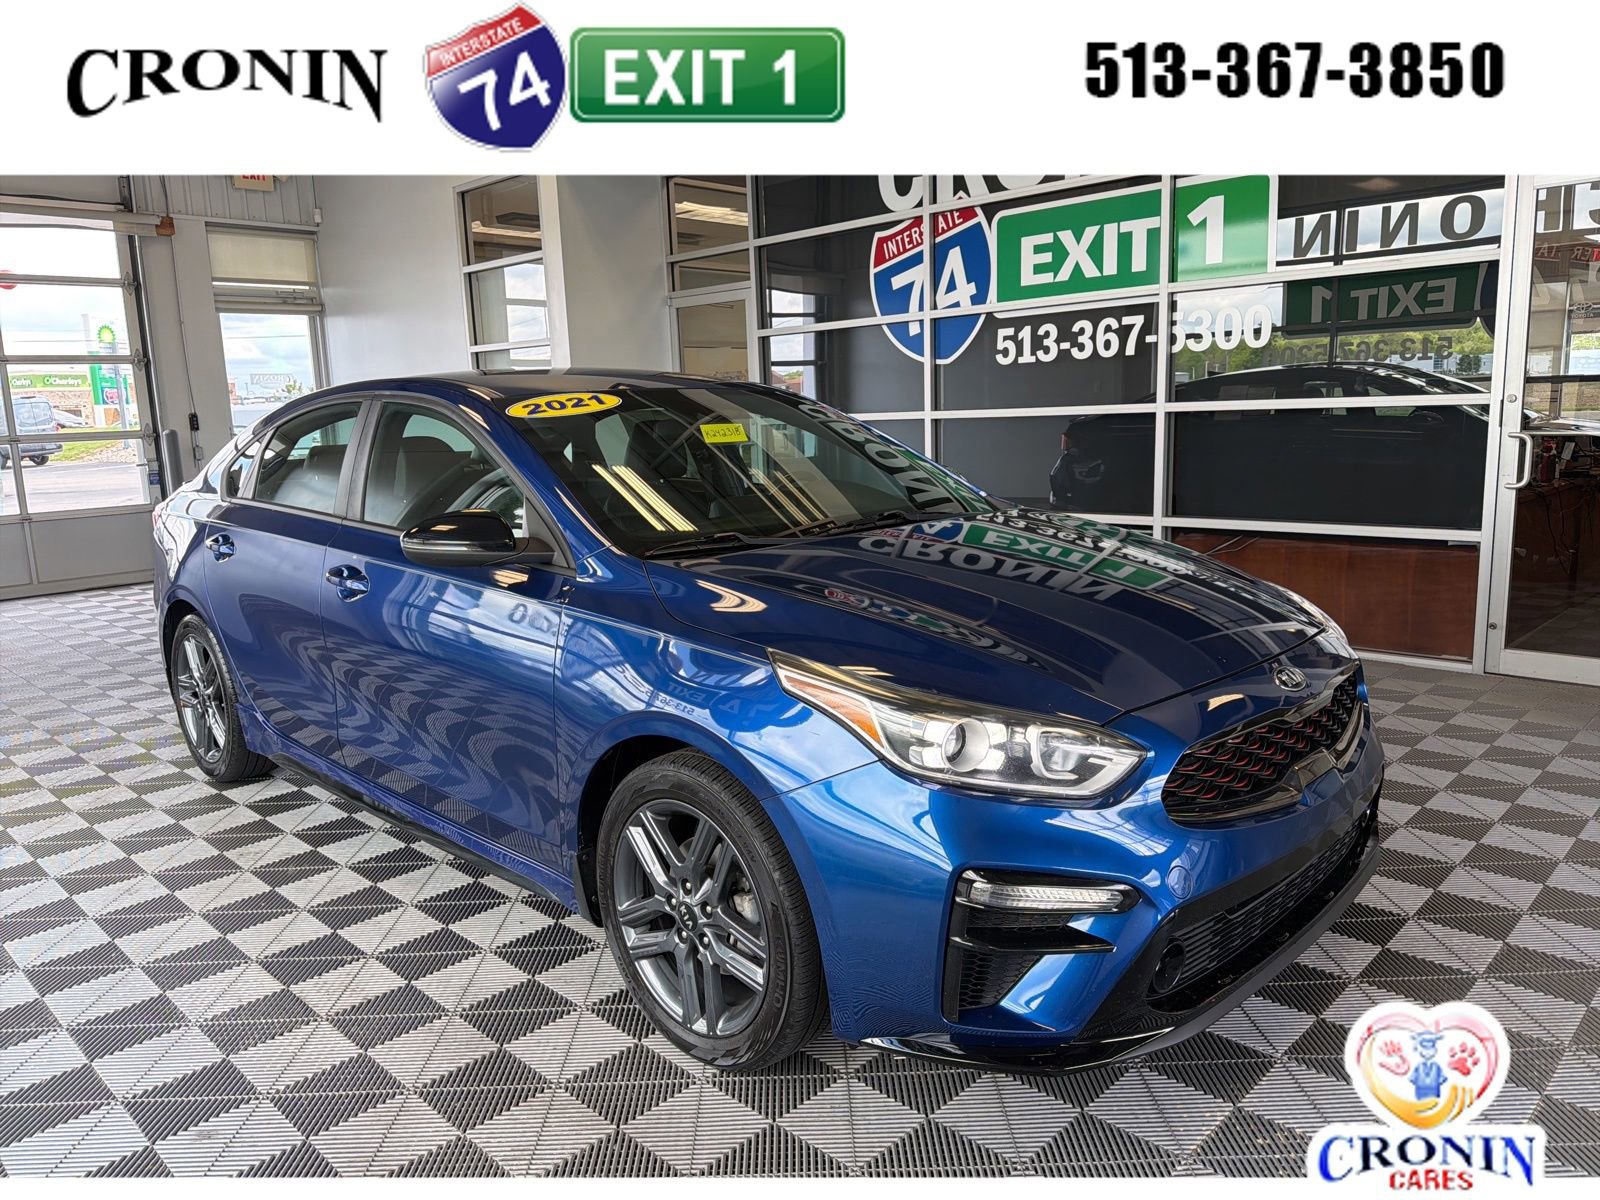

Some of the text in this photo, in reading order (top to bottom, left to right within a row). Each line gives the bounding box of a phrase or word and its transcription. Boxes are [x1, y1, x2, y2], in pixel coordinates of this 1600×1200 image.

[883, 209, 964, 260] INTERATE
[1020, 195, 1225, 287] EXIT 1
[891, 246, 977, 335] 74
[995, 304, 1272, 366] 513-367-5300
[522, 395, 607, 416] 2021
[1277, 669, 1305, 688] KIA
[679, 904, 694, 930] KIA
